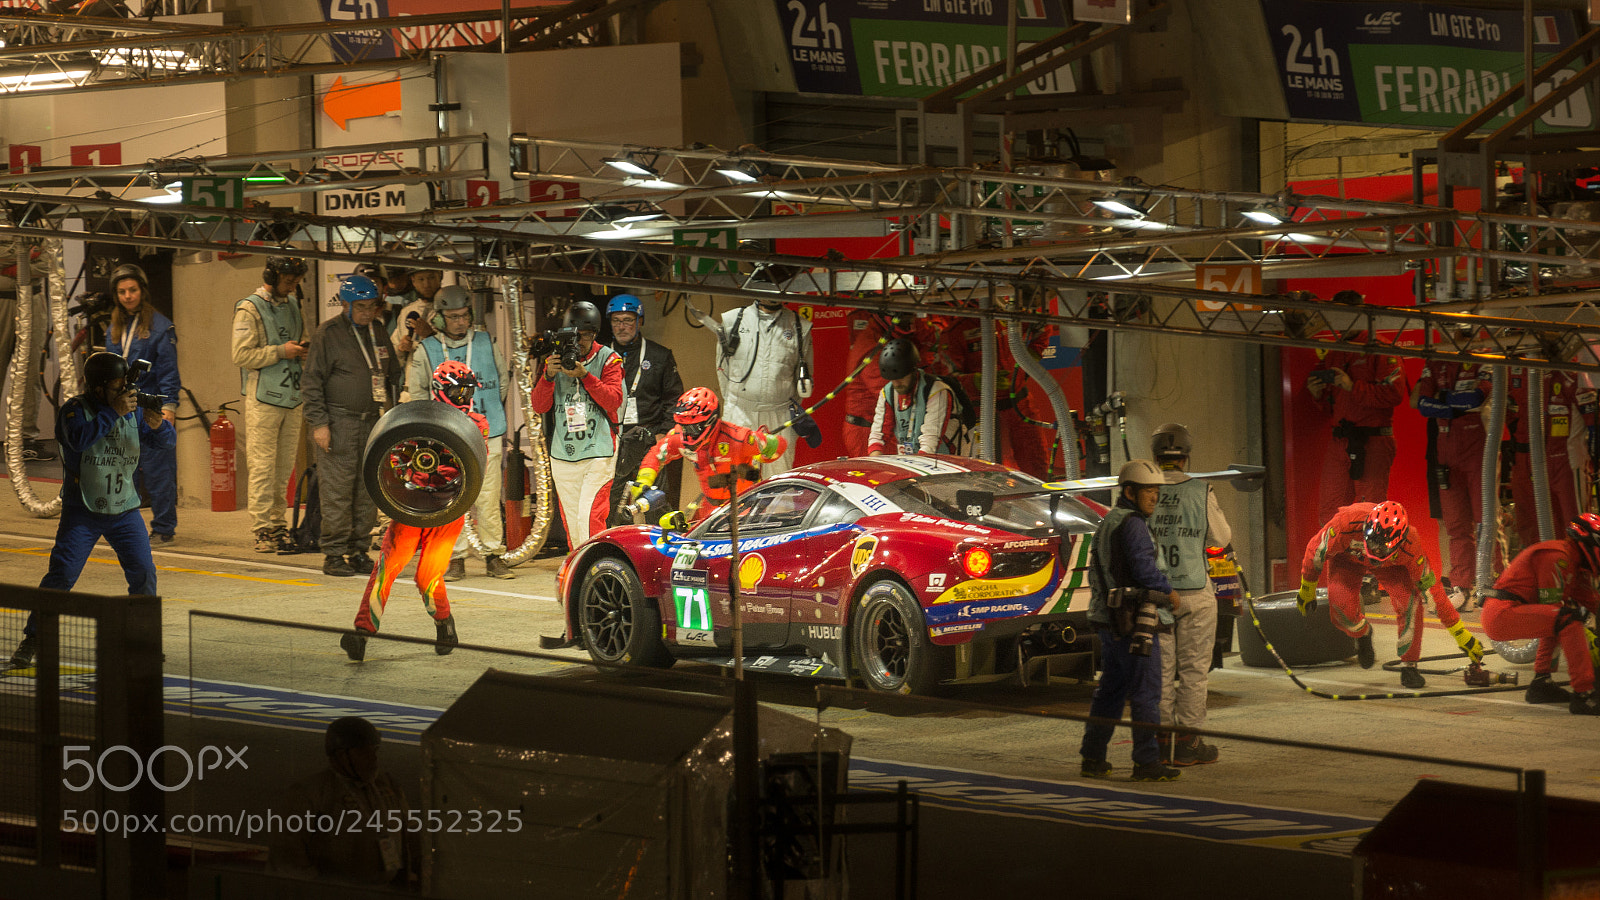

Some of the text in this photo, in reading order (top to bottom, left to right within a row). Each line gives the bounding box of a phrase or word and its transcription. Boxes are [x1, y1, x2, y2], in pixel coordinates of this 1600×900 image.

[1429, 12, 1501, 42] LM GTE Pro
[793, 49, 845, 65] LE MANS
[1287, 74, 1345, 92] LE MANS
[20, 150, 30, 174] 1
[191, 179, 235, 218] 51
[325, 192, 381, 211] DMG
[682, 231, 729, 273] 71
[1203, 267, 1254, 310] 54
[280, 367, 301, 391] 28
[84, 455, 118, 467] PITLANE
[105, 473, 124, 495] 15
[1154, 514, 1183, 526] MEDIA
[739, 534, 793, 552] RACING
[968, 588, 1025, 600] CORPORATION
[676, 587, 709, 630] 71
[971, 603, 1023, 615] SMP RACING
[943, 623, 983, 633] MICHELIN
